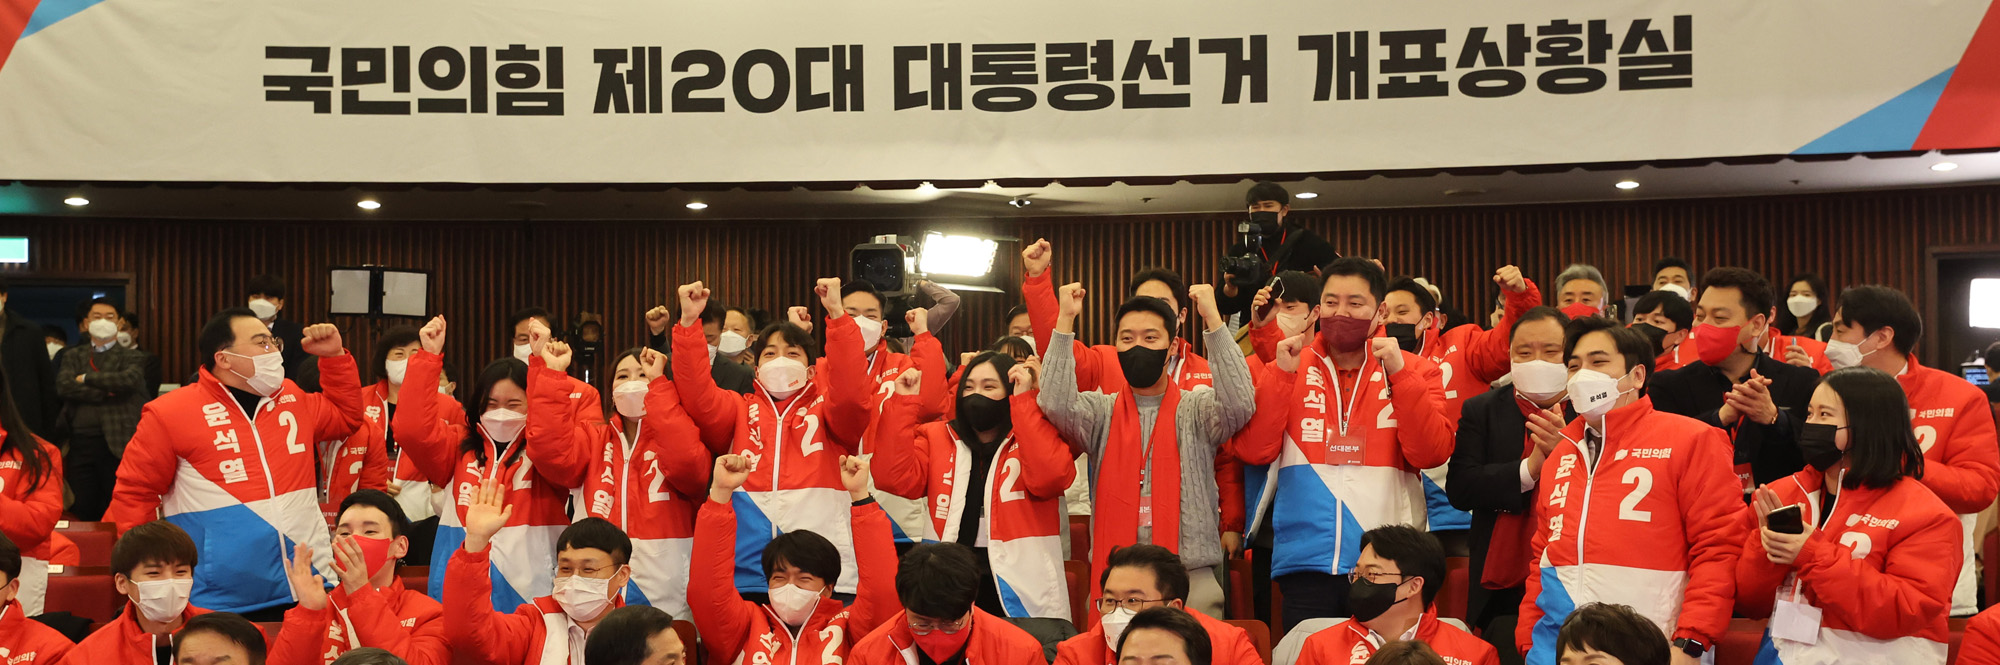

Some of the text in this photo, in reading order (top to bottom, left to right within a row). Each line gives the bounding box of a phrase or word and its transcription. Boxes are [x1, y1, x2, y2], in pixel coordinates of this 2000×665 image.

[263, 15, 1693, 116] 국민의힘 제20대 대통령선거 개표상황실
[1301, 366, 1326, 443] 윤석열
[1590, 391, 1608, 403] 윤석열
[202, 402, 248, 484] 윤석열
[278, 410, 306, 455] 2
[795, 414, 824, 457] 2
[1631, 448, 1673, 459] 국민의힘
[644, 459, 671, 504] 2
[1000, 457, 1026, 503] 2
[1548, 454, 1578, 543] 윤석열
[1619, 466, 1654, 523] 2
[1861, 513, 1900, 530] 국민의힘
[818, 624, 844, 665] 2
